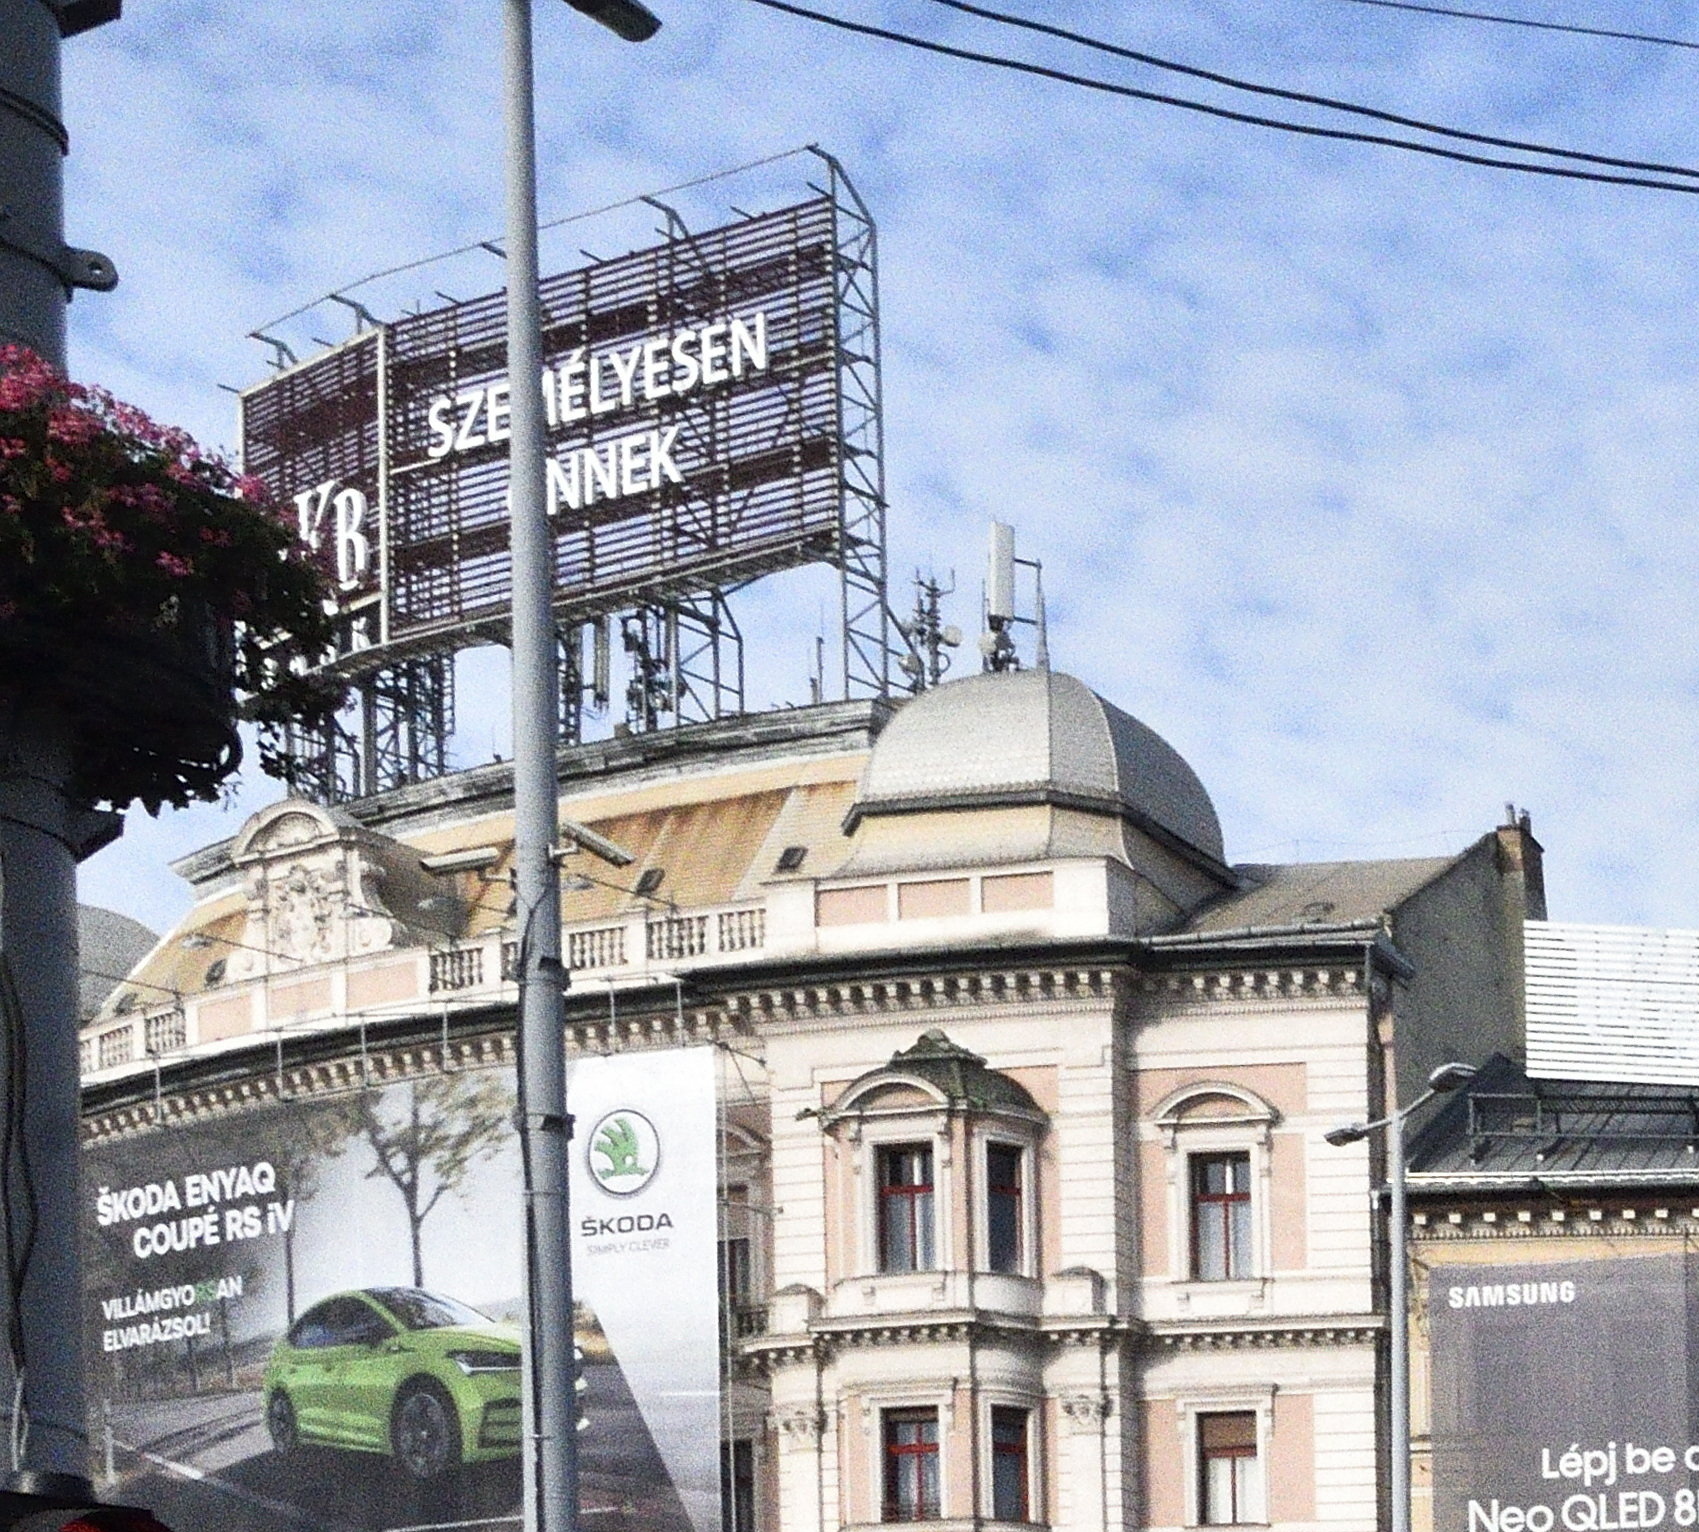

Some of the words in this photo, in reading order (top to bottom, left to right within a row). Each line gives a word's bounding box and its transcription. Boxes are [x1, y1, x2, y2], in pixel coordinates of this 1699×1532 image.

[427, 312, 766, 457] SZEÉLYESEN
[507, 427, 684, 515] NNEK
[97, 1186, 181, 1226] ŠKODA
[185, 1161, 276, 1207] ENYAQ
[133, 1206, 220, 1259] COUPÉ
[225, 1205, 262, 1241] RS
[267, 1200, 294, 1234] iV
[581, 1213, 674, 1237] ŠKODA
[1448, 1281, 1576, 1308] SAMSUNG
[103, 1312, 211, 1352] ELVARÁZSOL!
[1541, 1442, 1617, 1487] Lépj
[1625, 1443, 1677, 1475] be
[1561, 1491, 1666, 1531] QLED
